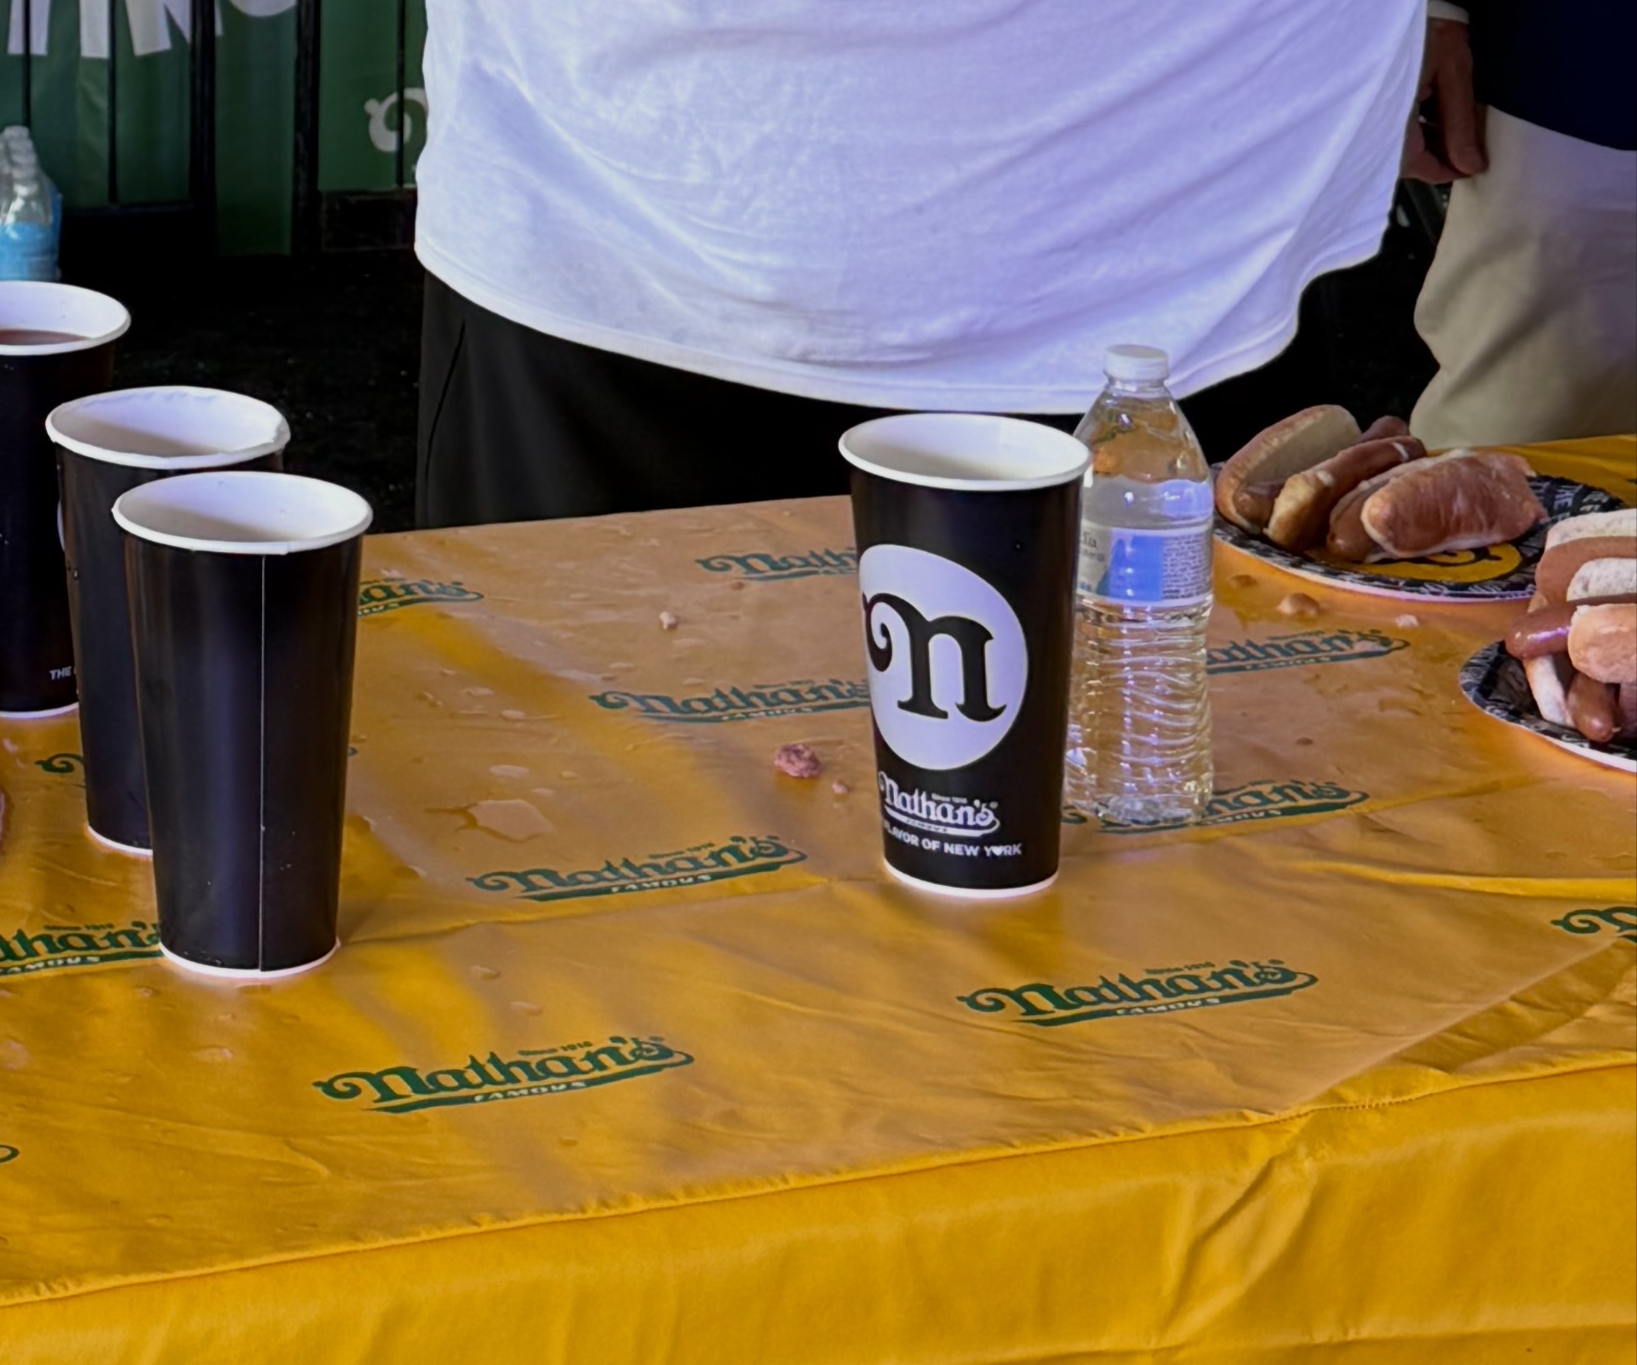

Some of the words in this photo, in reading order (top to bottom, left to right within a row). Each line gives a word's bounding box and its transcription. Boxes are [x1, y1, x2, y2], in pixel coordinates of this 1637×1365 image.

[49, 666, 73, 680] THE
[879, 771, 998, 827] Nathan's
[465, 836, 790, 893] Nathan's
[921, 837, 941, 852] OF
[943, 840, 980, 857] NEW
[956, 959, 1297, 1017] Nathan's
[312, 1035, 676, 1104] Nathan's
[474, 1081, 587, 1103] FAMOUS
